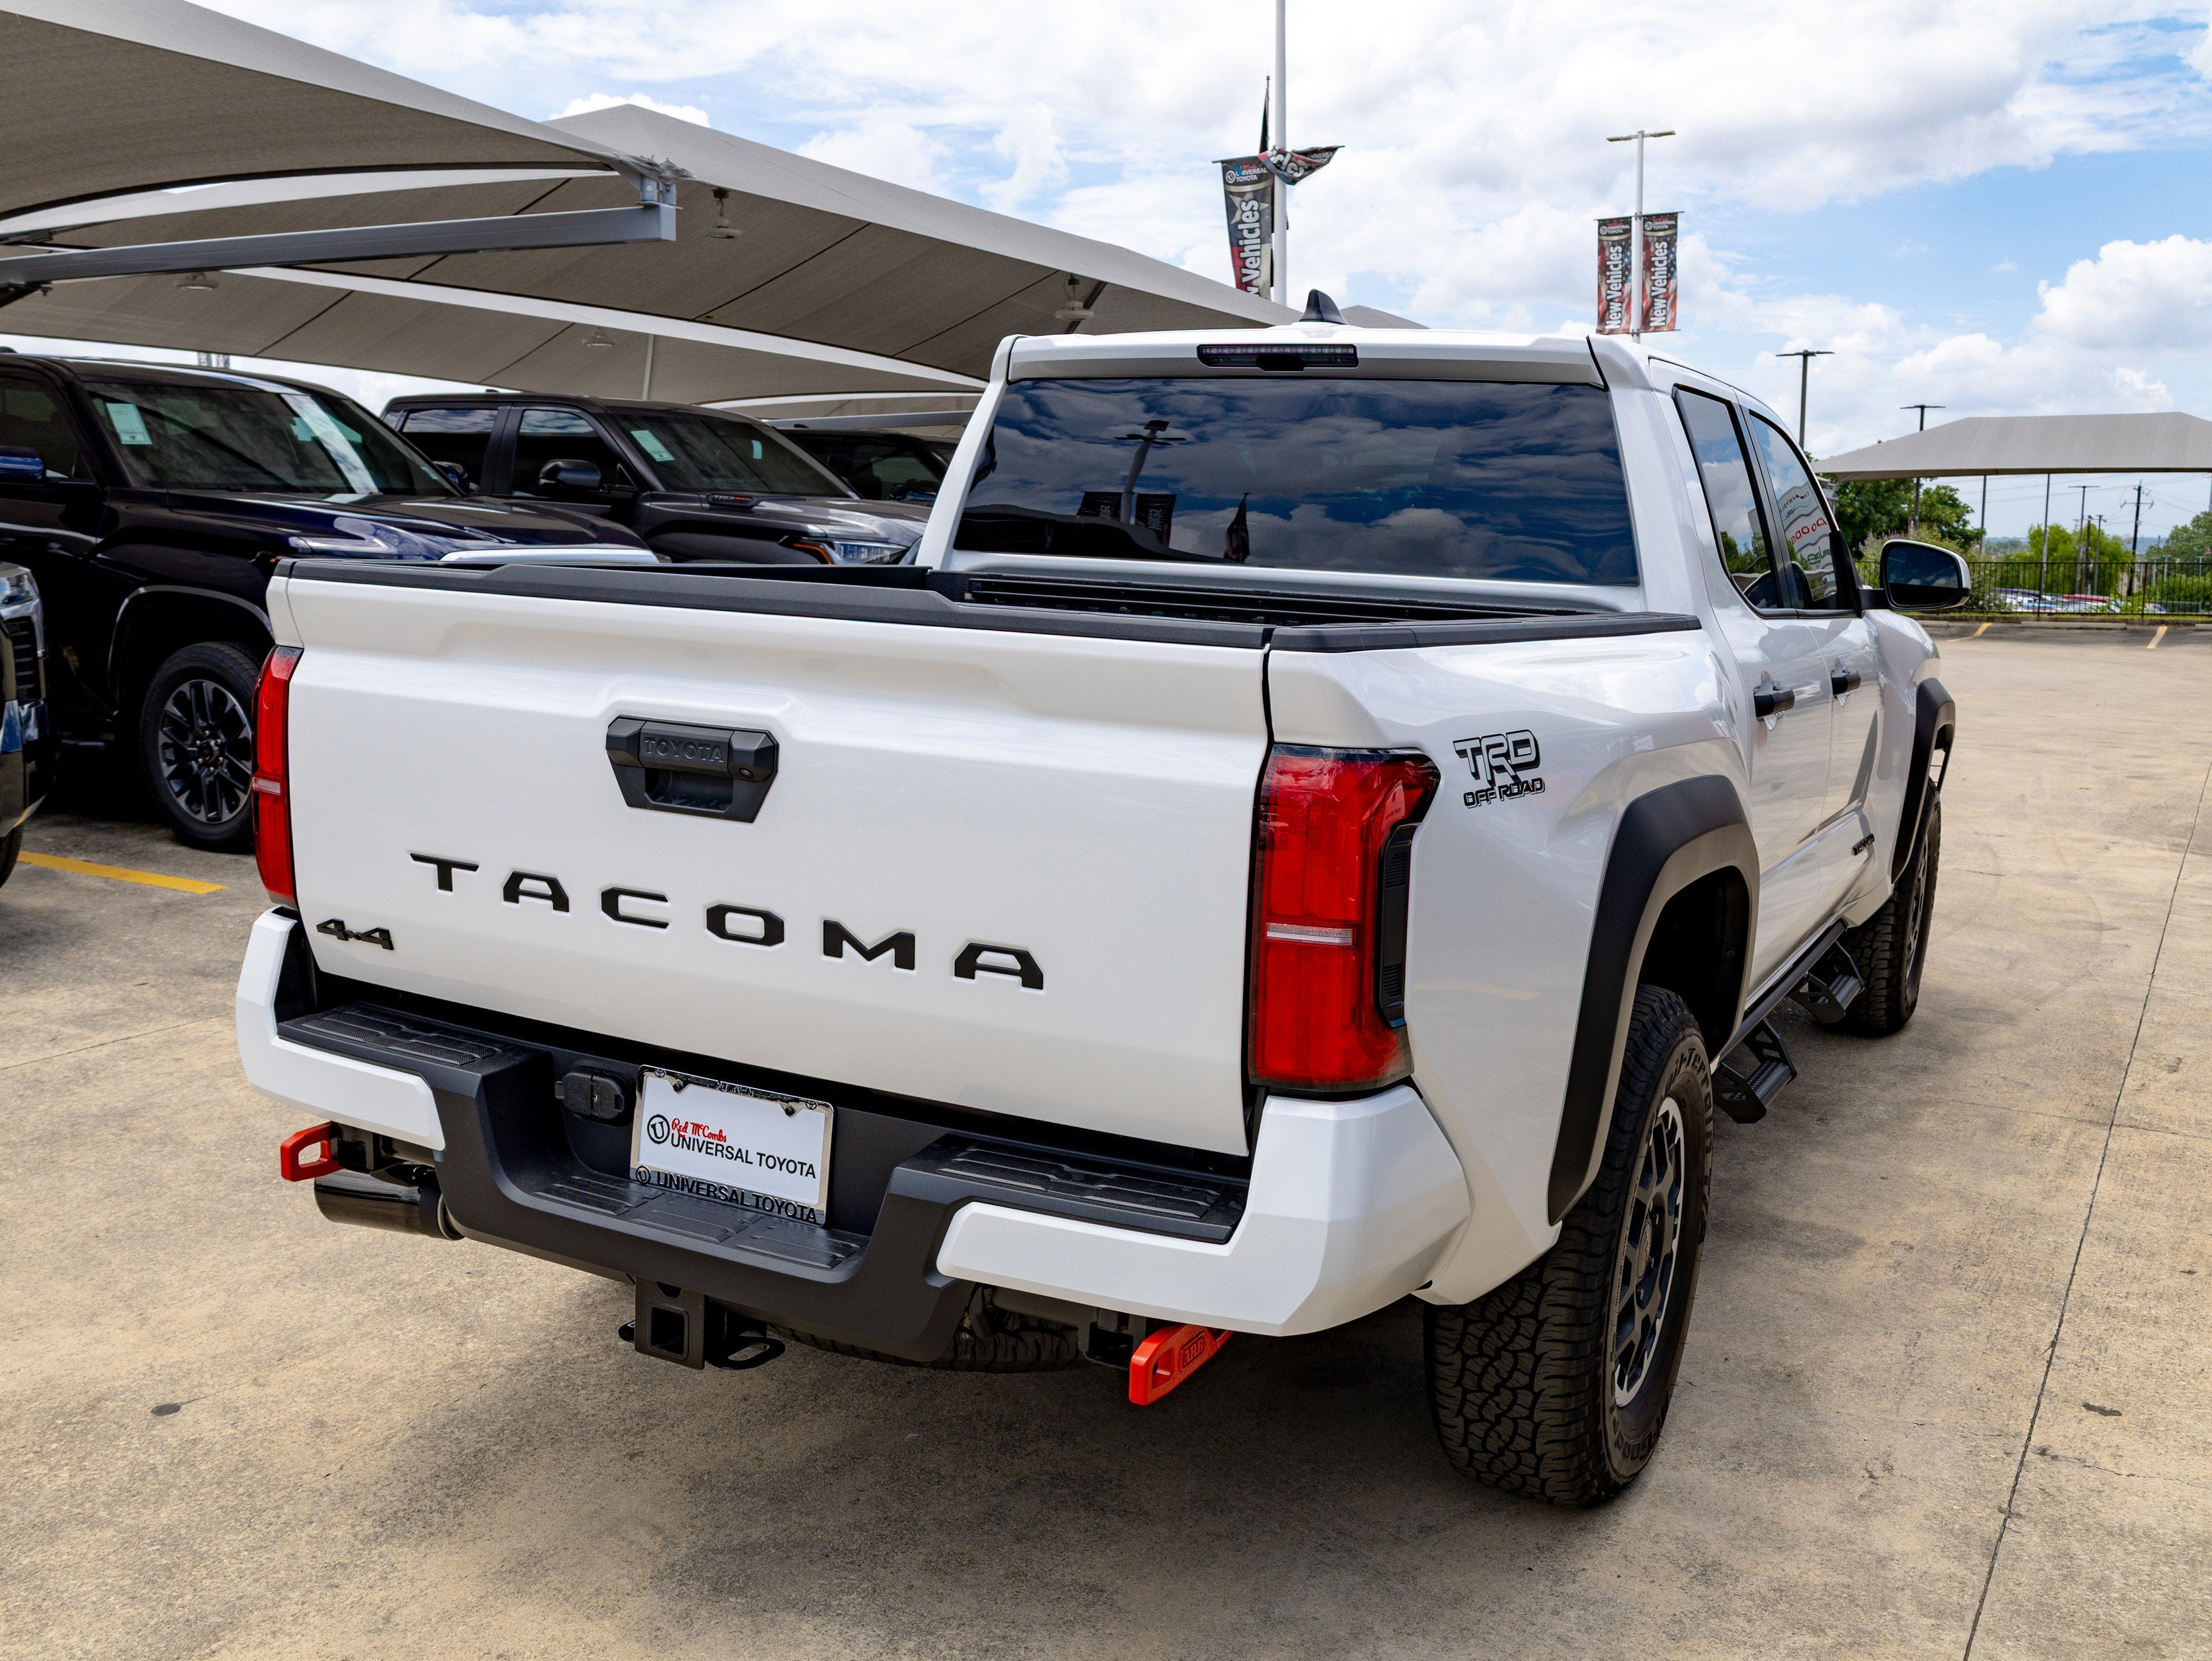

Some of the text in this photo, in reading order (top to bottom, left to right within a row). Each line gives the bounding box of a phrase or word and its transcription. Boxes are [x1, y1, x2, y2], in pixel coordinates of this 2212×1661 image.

[1235, 175, 1258, 183] TOYOTA
[1237, 199, 1261, 283] Vehicles
[1606, 245, 1623, 300] Vehicles
[1651, 241, 1668, 300] Vehicles
[1605, 301, 1622, 330] New
[1650, 298, 1666, 327] New
[644, 737, 724, 763] TOYOTA
[1453, 729, 1540, 789] TRD
[1463, 778, 1545, 808] OFF ROAD
[409, 853, 1044, 990] TACOMA
[671, 1118, 726, 1142] Red McCombs
[671, 1133, 816, 1179] UNIVERSAL TOYOTA
[657, 1171, 817, 1223] UNIVERSAL TOYOTA
[1183, 1338, 1204, 1366] ARB
